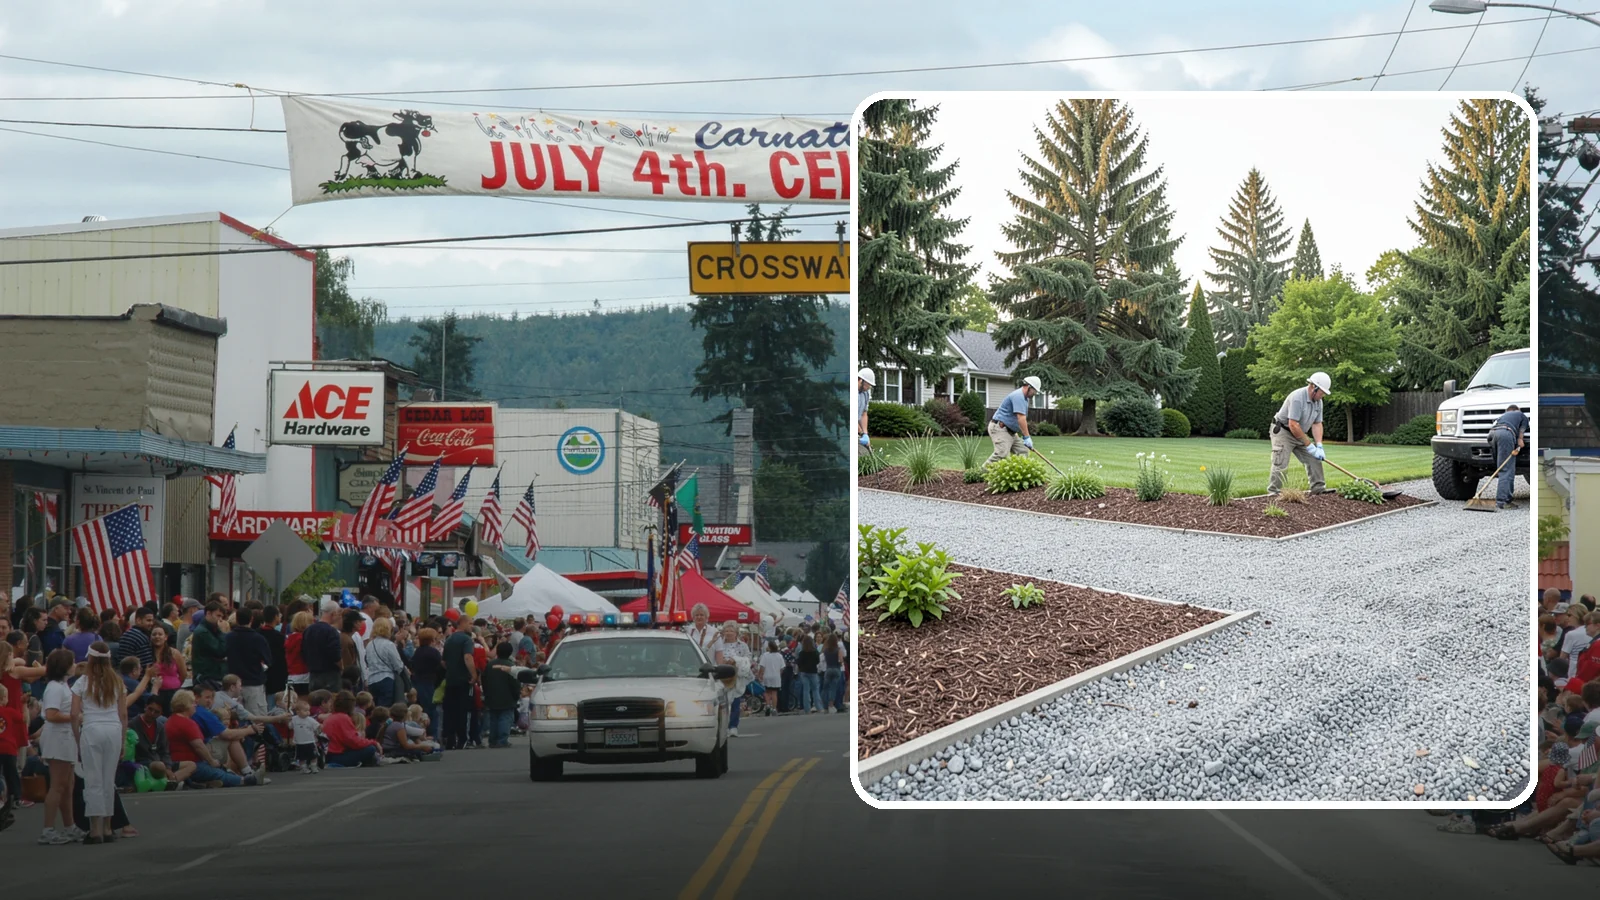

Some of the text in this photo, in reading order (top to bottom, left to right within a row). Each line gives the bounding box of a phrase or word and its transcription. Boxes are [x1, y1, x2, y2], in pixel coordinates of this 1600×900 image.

[481, 141, 605, 192] JULY
[632, 150, 747, 198] 4th.
[697, 254, 850, 280] CROSSWA
[283, 380, 373, 420] ACE
[405, 409, 452, 422] CEDAR
[283, 421, 370, 437] Hardware
[353, 467, 386, 480] Simpl
[83, 485, 155, 495] St. Vincent de Paul
[688, 526, 741, 535] CRNATION
[699, 535, 730, 543] GLASS
